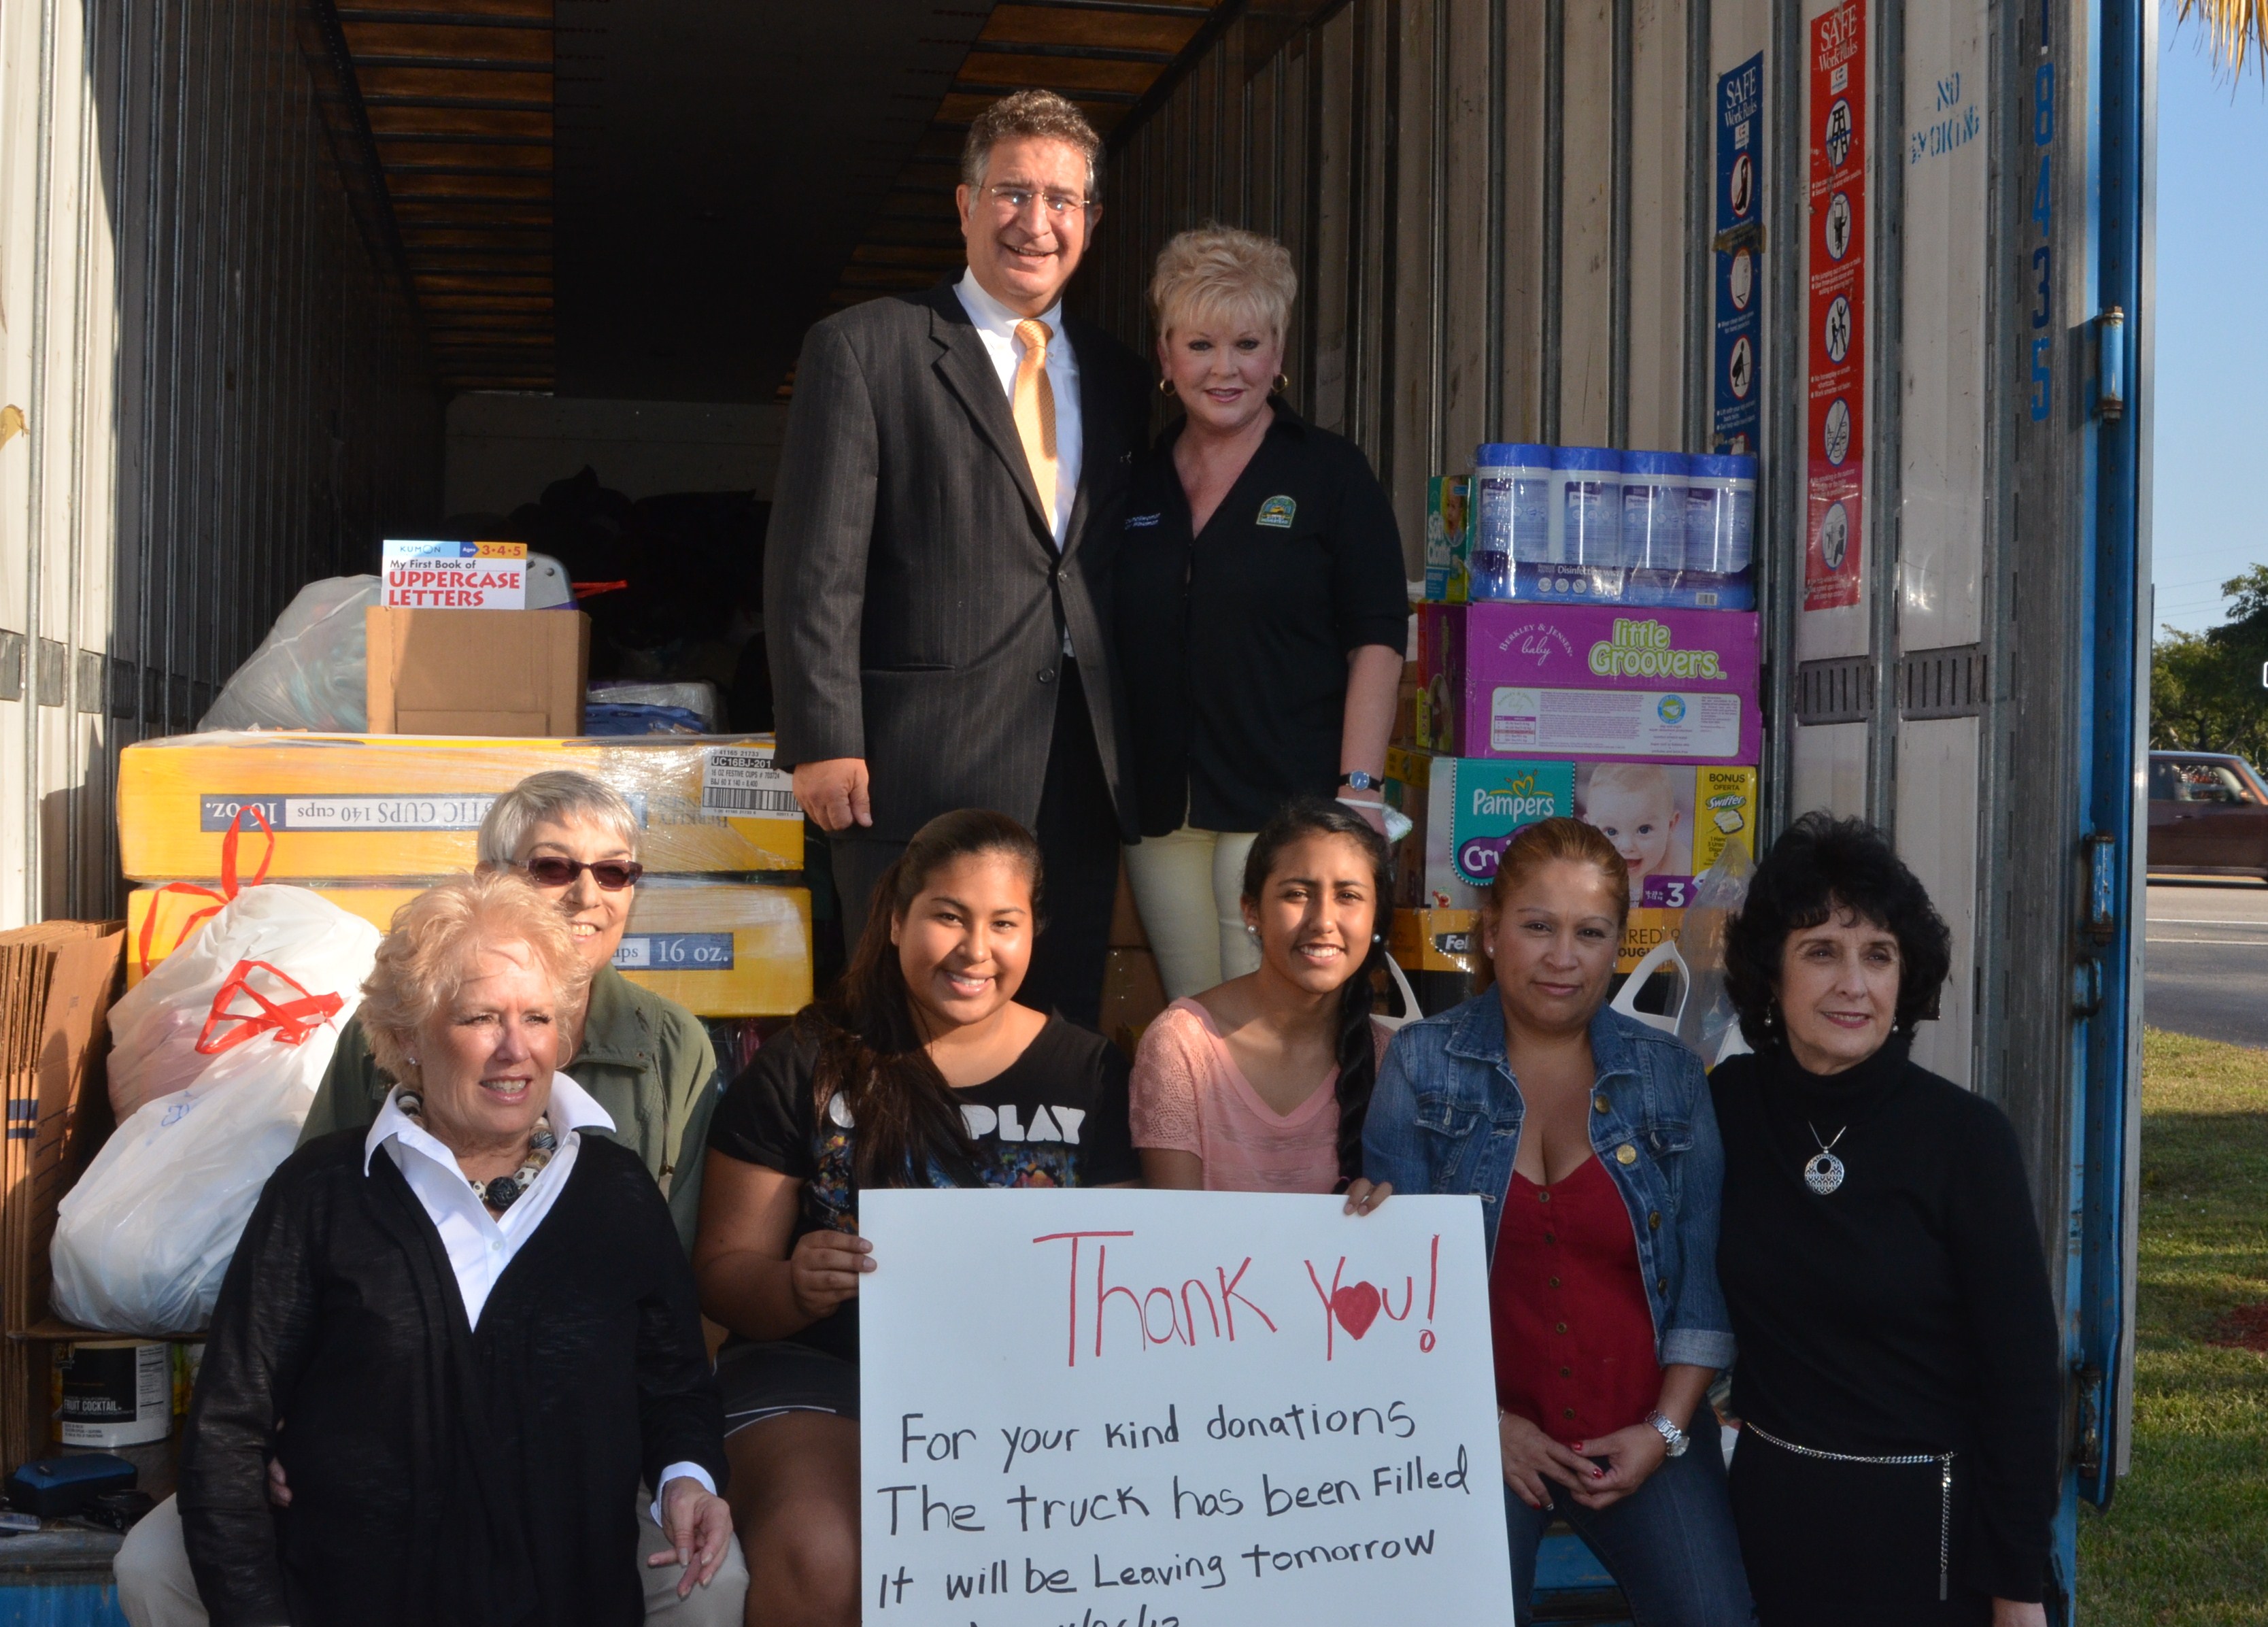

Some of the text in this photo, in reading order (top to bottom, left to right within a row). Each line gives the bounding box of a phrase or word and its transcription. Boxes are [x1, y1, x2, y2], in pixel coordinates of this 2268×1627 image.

[1821, 4, 1857, 52] SAFE
[1819, 48, 1840, 72] Work
[1726, 67, 1757, 109] SAFE
[1725, 97, 1757, 128] Work Rules
[400, 545, 441, 554] KUMON
[390, 559, 477, 571] My First Book of
[1557, 565, 1602, 576] Disinfecting
[389, 571, 520, 589] UPPERCASE
[388, 590, 484, 607] LETTERS
[1499, 624, 1535, 652] BERKLEY
[1538, 623, 1546, 632] &
[1614, 620, 1670, 648] little
[1521, 635, 1551, 666] baby
[1590, 642, 1718, 677] Groovers
[711, 756, 771, 768] UC16BJ-201
[745, 771, 758, 779] CUPS
[1709, 773, 1745, 782] BONUS
[297, 802, 335, 817] cups
[378, 802, 435, 824] CUPS
[1473, 788, 1555, 823] Pampers
[1707, 794, 1744, 810] Swiffer
[205, 803, 278, 826] 16 oz.
[341, 807, 371, 822] 140
[1666, 882, 1685, 907] 3
[613, 939, 728, 962] ups 16 oz.
[1032, 1230, 1278, 1367] Thank
[64, 1399, 118, 1411] FRUIT COCKTAIL
[902, 1413, 977, 1464] For
[1002, 1423, 1080, 1473] your
[1206, 1400, 1417, 1440] donations
[877, 1443, 1470, 1536] The truck has been Filled
[879, 1528, 1436, 1609] It will be Leaving tomorrow
